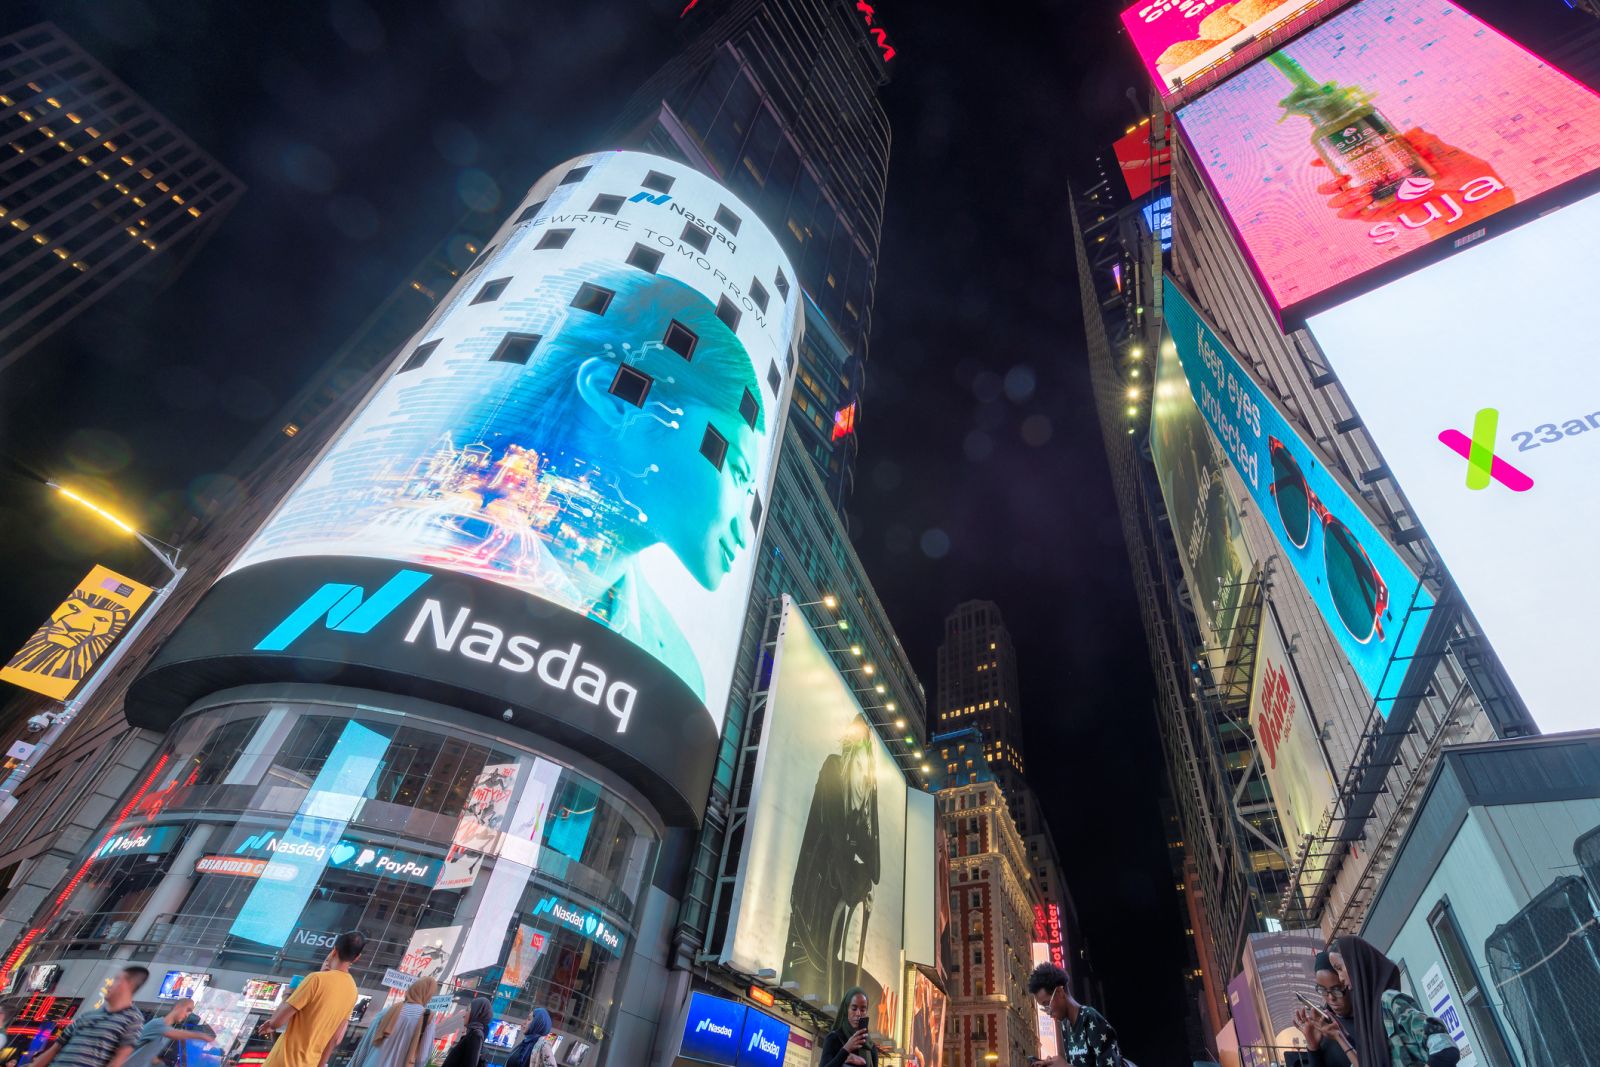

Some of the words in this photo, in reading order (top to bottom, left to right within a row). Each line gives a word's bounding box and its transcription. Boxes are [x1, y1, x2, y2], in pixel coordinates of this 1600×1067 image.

[670, 203, 738, 254] Nasdaq
[1368, 175, 1504, 243] suja
[644, 228, 767, 329] TOMORROW
[1197, 322, 1225, 391] Keep
[1228, 372, 1261, 438] eyes
[1201, 381, 1258, 490] protected
[1197, 465, 1211, 517] 1960
[404, 598, 638, 733] Nasdaq
[196, 859, 254, 873] BRANDED
[266, 838, 326, 861] Nasdaq
[375, 856, 428, 877] PayPal
[294, 929, 338, 948] Nasd
[552, 904, 585, 931] Nasdaq
[602, 930, 619, 947] PayPal
[1048, 904, 1060, 943] Locker
[1051, 947, 1062, 969] oot
[708, 1023, 732, 1038] Nasdaq
[1440, 1005, 1459, 1034] YPD
[759, 1036, 780, 1060] Nasdaq
